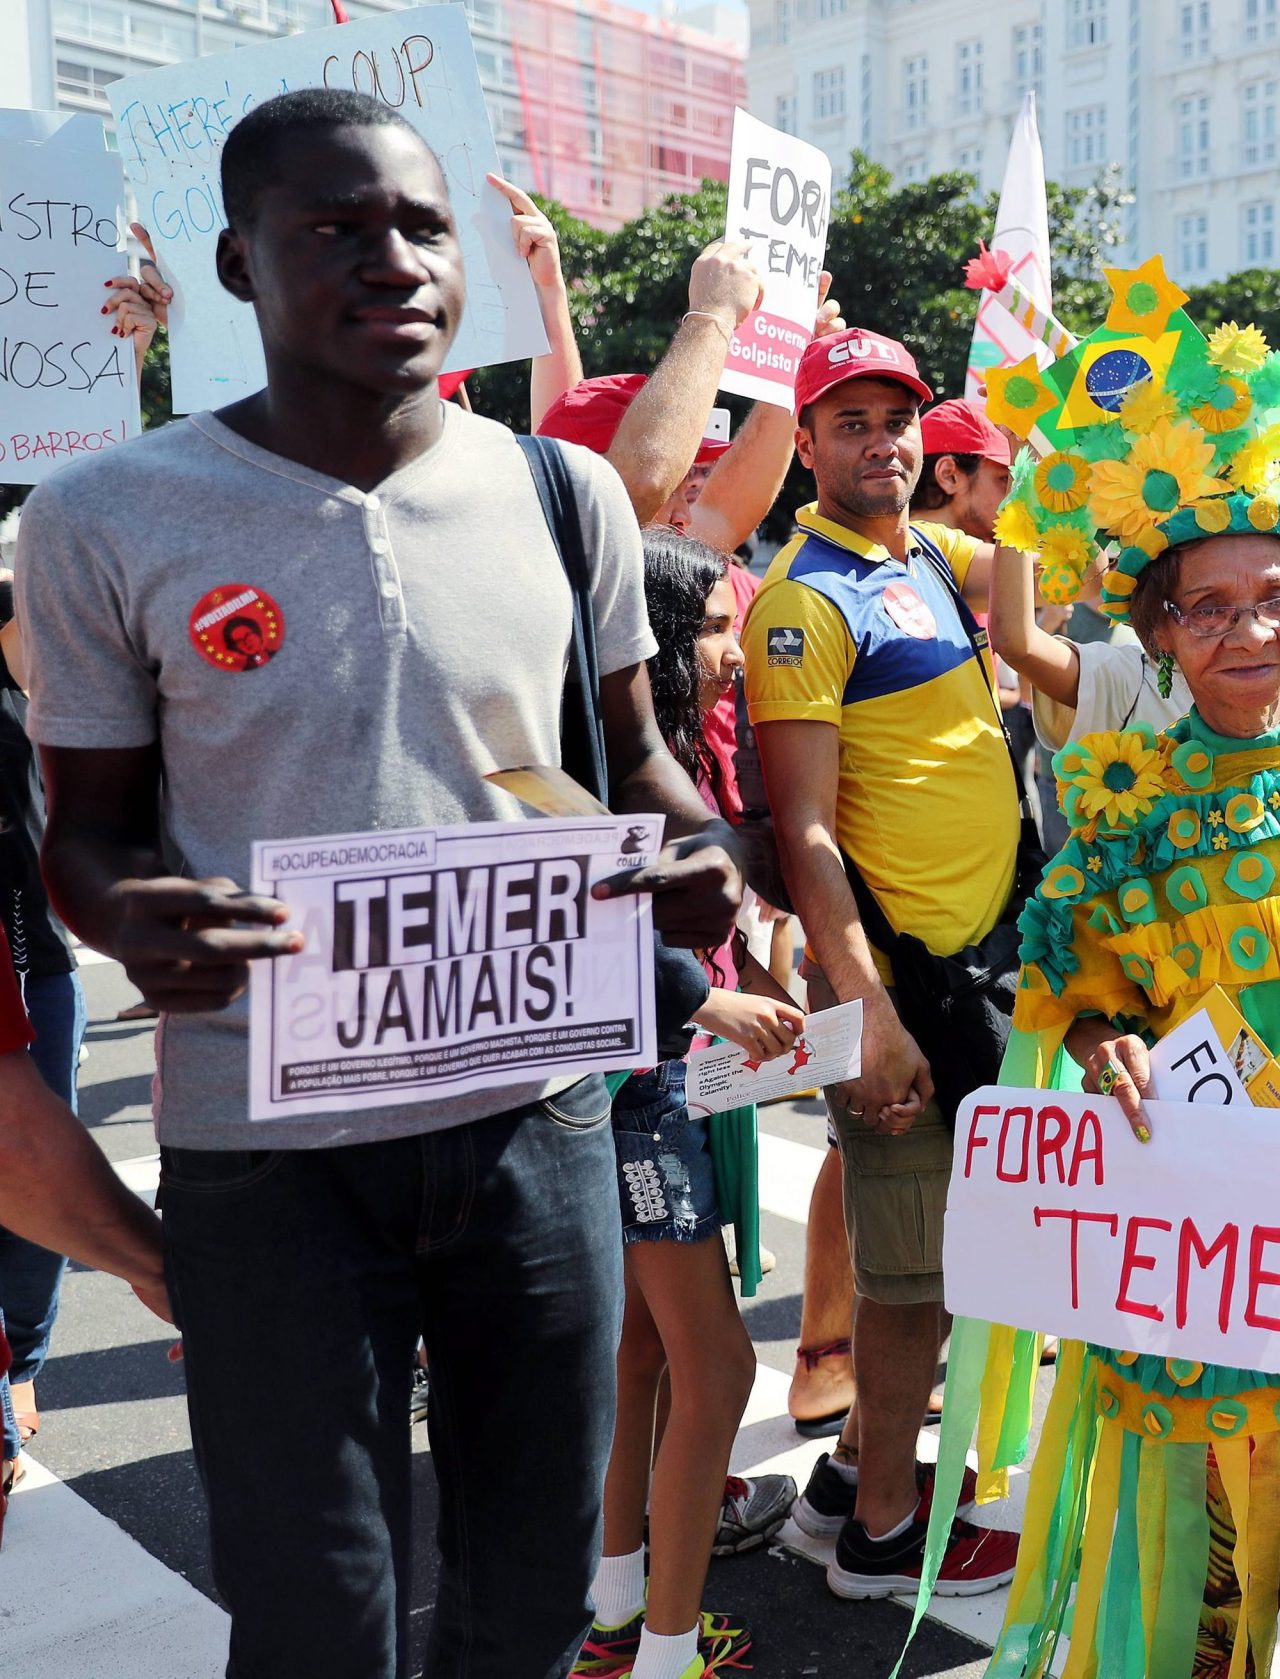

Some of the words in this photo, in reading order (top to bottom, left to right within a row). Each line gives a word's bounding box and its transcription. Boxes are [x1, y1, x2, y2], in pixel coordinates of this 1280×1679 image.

[121, 80, 252, 166] THERE'
[0, 193, 120, 247] STRO
[730, 337, 792, 373] Golpista
[828, 338, 892, 363] CUT
[272, 841, 428, 872] #OCUPEADEMOCRACIA
[335, 858, 580, 970] TEMER
[336, 943, 574, 1050] JAMAIS!
[289, 1066, 320, 1077] PORQUE
[327, 1062, 339, 1071] UM
[340, 1058, 376, 1070] GOVERNO
[414, 1051, 443, 1062] PORQUE
[449, 1048, 459, 1057] UM
[460, 1042, 489, 1056] GOVERNO
[490, 1037, 524, 1049] MACHISTA,
[524, 1033, 551, 1044] PORQUE
[558, 1031, 568, 1039] UM
[569, 1027, 600, 1038] GOVERNO
[600, 1024, 627, 1035] CONTRA
[298, 1074, 342, 1088] POPULAÇÃO
[343, 1074, 361, 1083] MAIS
[390, 1068, 419, 1079] PORQUE
[426, 1065, 437, 1074] UM
[437, 1060, 468, 1073] GOVERNO
[469, 1057, 482, 1067] QUE
[482, 1054, 500, 1064] QUER
[501, 1050, 528, 1061] ACABAR
[529, 1048, 544, 1057] COM
[544, 1046, 554, 1055] AS
[554, 1041, 595, 1053] CONQUISTAS
[964, 1104, 1104, 1187] FORA
